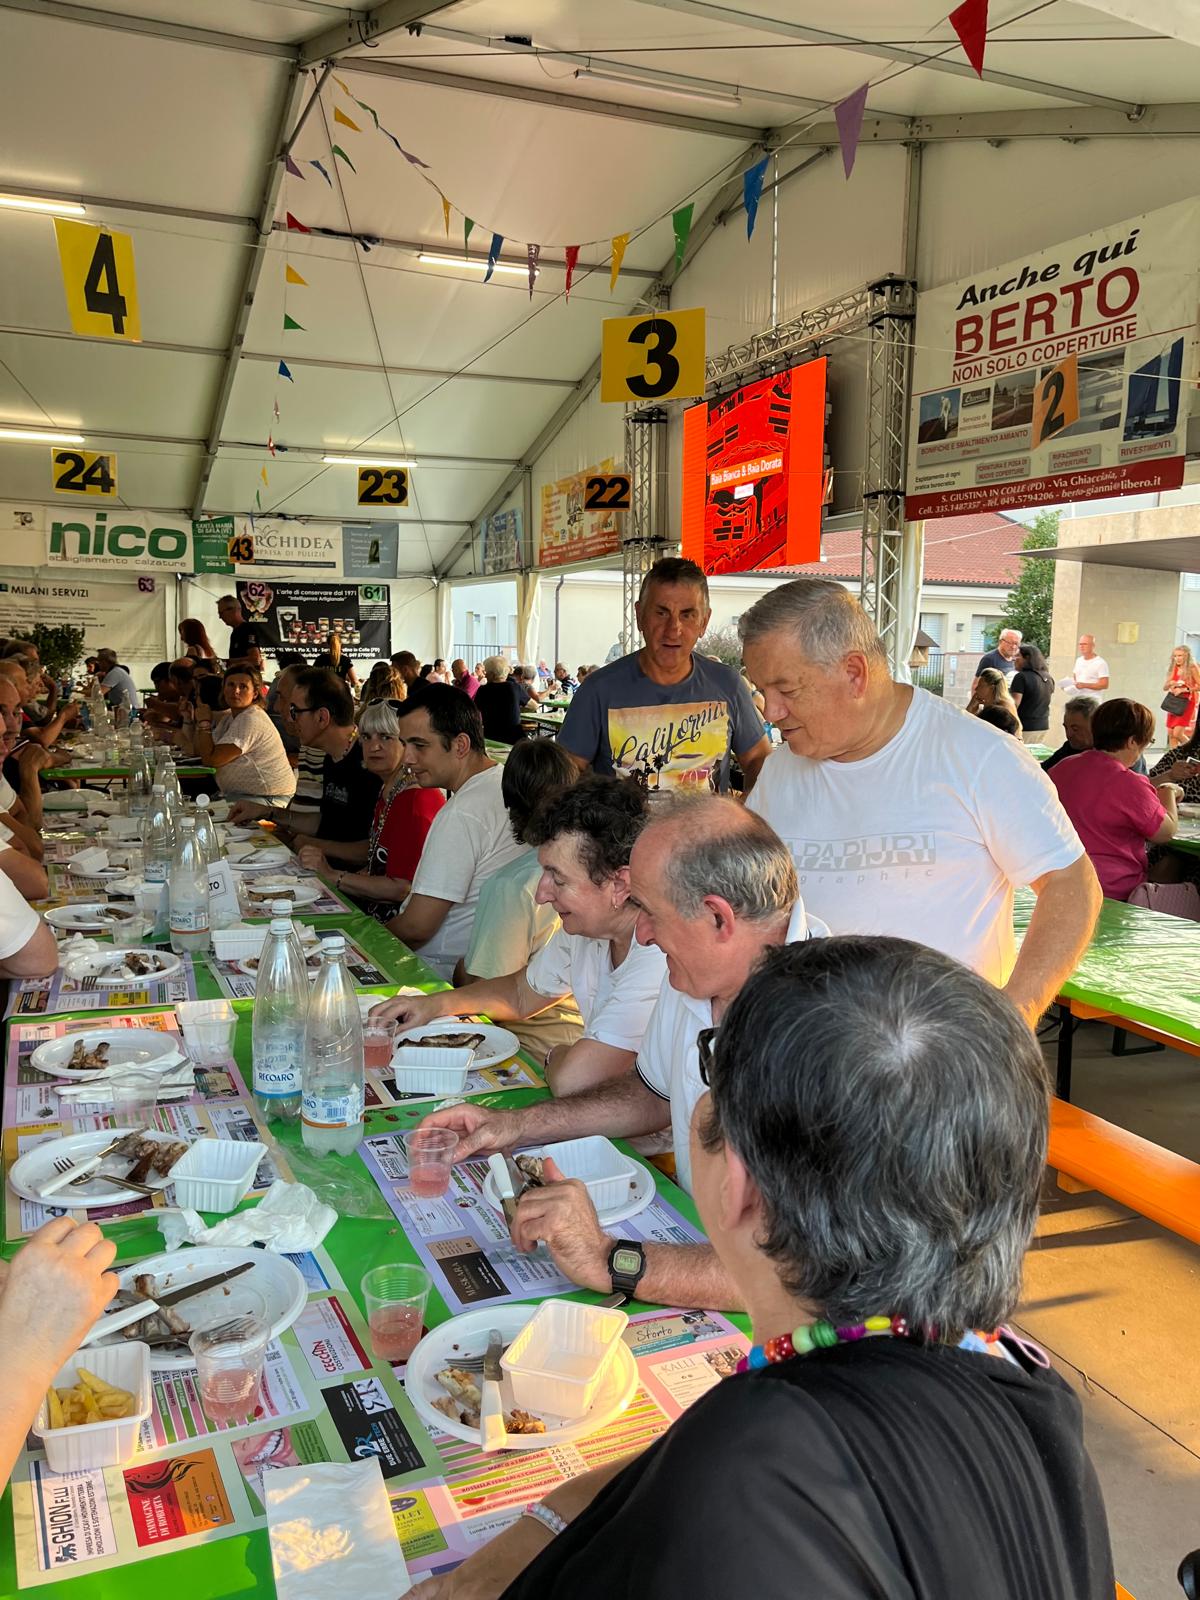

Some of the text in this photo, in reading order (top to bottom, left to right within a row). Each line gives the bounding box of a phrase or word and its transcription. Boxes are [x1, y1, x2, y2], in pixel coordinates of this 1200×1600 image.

[84, 233, 128, 335] 4
[956, 229, 1140, 310] Anche qui
[955, 266, 1140, 361] BERTO
[625, 318, 680, 398] 3
[952, 321, 1138, 383] NON SOLO COPERTURE
[1039, 370, 1065, 445] 2
[921, 443, 950, 456] BONIFICHE
[956, 434, 998, 449] SMALTIMENTO
[1000, 429, 1028, 441] AMIANTO
[1052, 448, 1092, 460] RIFACIMENTO
[1120, 439, 1171, 457] RIVESTIMENTI
[54, 452, 116, 493] 24
[760, 458, 782, 472] Dorata
[1053, 457, 1089, 469] COPERTURE
[358, 468, 408, 504] 23
[584, 476, 630, 510] 22
[918, 506, 934, 516] Cell.
[1061, 475, 1162, 499] berto-gianni@libero.it
[941, 495, 947, 503] S.
[950, 489, 987, 501] GIUSTINA
[989, 488, 998, 496] IN
[1001, 483, 1025, 495] COLLE
[1028, 482, 1046, 492] (PD)
[1053, 477, 1068, 488] Via
[1121, 469, 1127, 478] 3
[50, 513, 188, 560] nico
[229, 538, 254, 561] 43
[255, 535, 333, 550] RCHIDEA
[135, 559, 187, 568] calzature
[11, 585, 89, 598] MILANI SERVIZI
[138, 577, 155, 593] 63
[249, 582, 265, 598] 62
[363, 586, 382, 602] 61
[612, 702, 724, 766] California
[786, 834, 931, 869] PAPIJRI
[258, 1072, 294, 1082] RECOARO
[451, 1262, 477, 1297] MASKARA
[312, 1340, 336, 1372] CECCHIN
[324, 1339, 345, 1370] COSTRUZIONI
[377, 1438, 390, 1454] ERRE
[385, 1453, 397, 1466] DUE
[48, 1504, 75, 1545] GHION
[141, 1497, 159, 1539] L'IMMAGINE
[153, 1495, 171, 1537] DI ROBERTA
